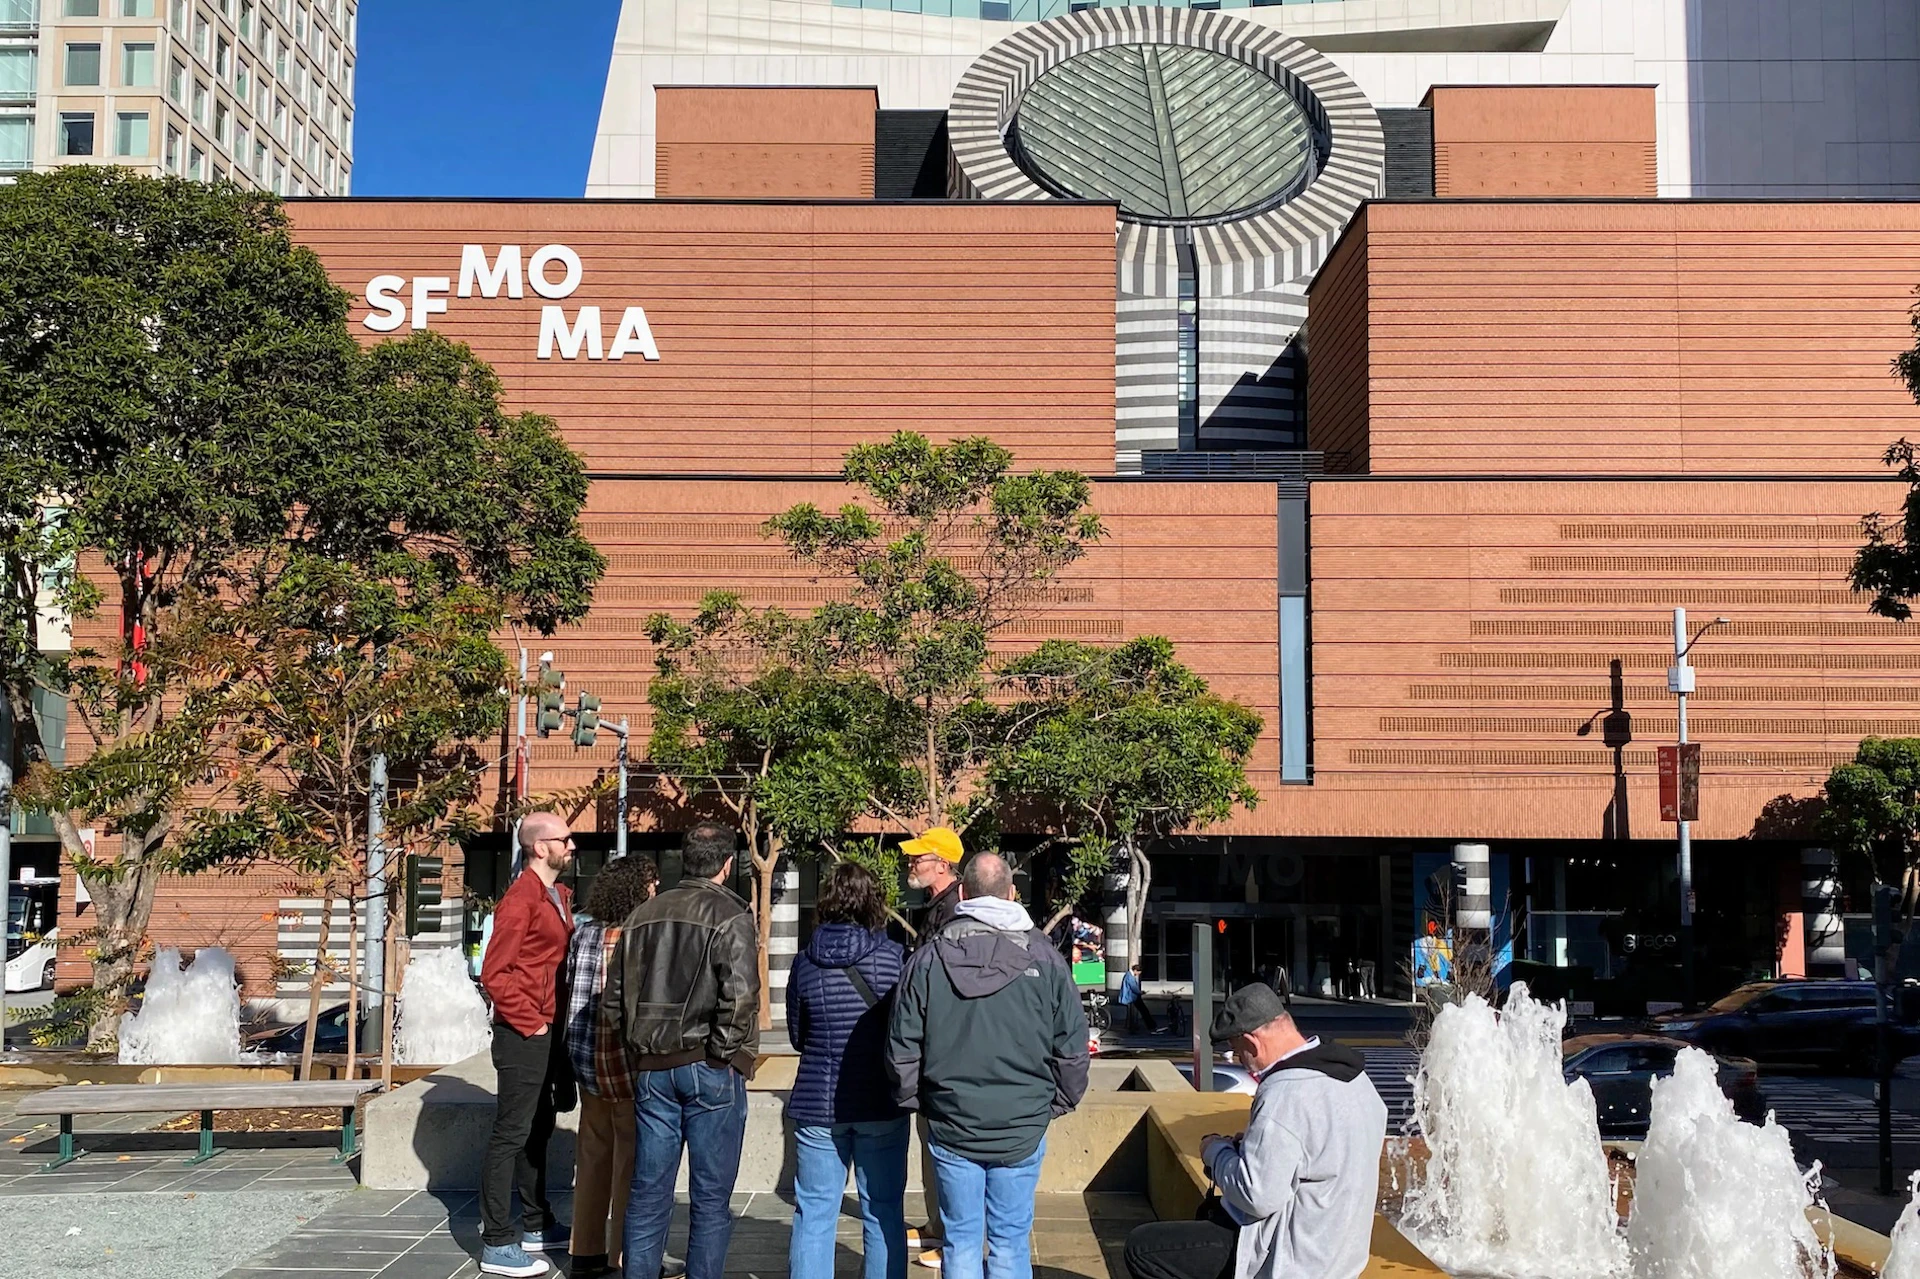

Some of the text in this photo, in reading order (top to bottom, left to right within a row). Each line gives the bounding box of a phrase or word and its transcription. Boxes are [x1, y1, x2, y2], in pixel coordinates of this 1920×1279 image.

[362, 244, 583, 332] SF MO
[537, 305, 660, 360] MA
[1623, 934, 1676, 953] grace
